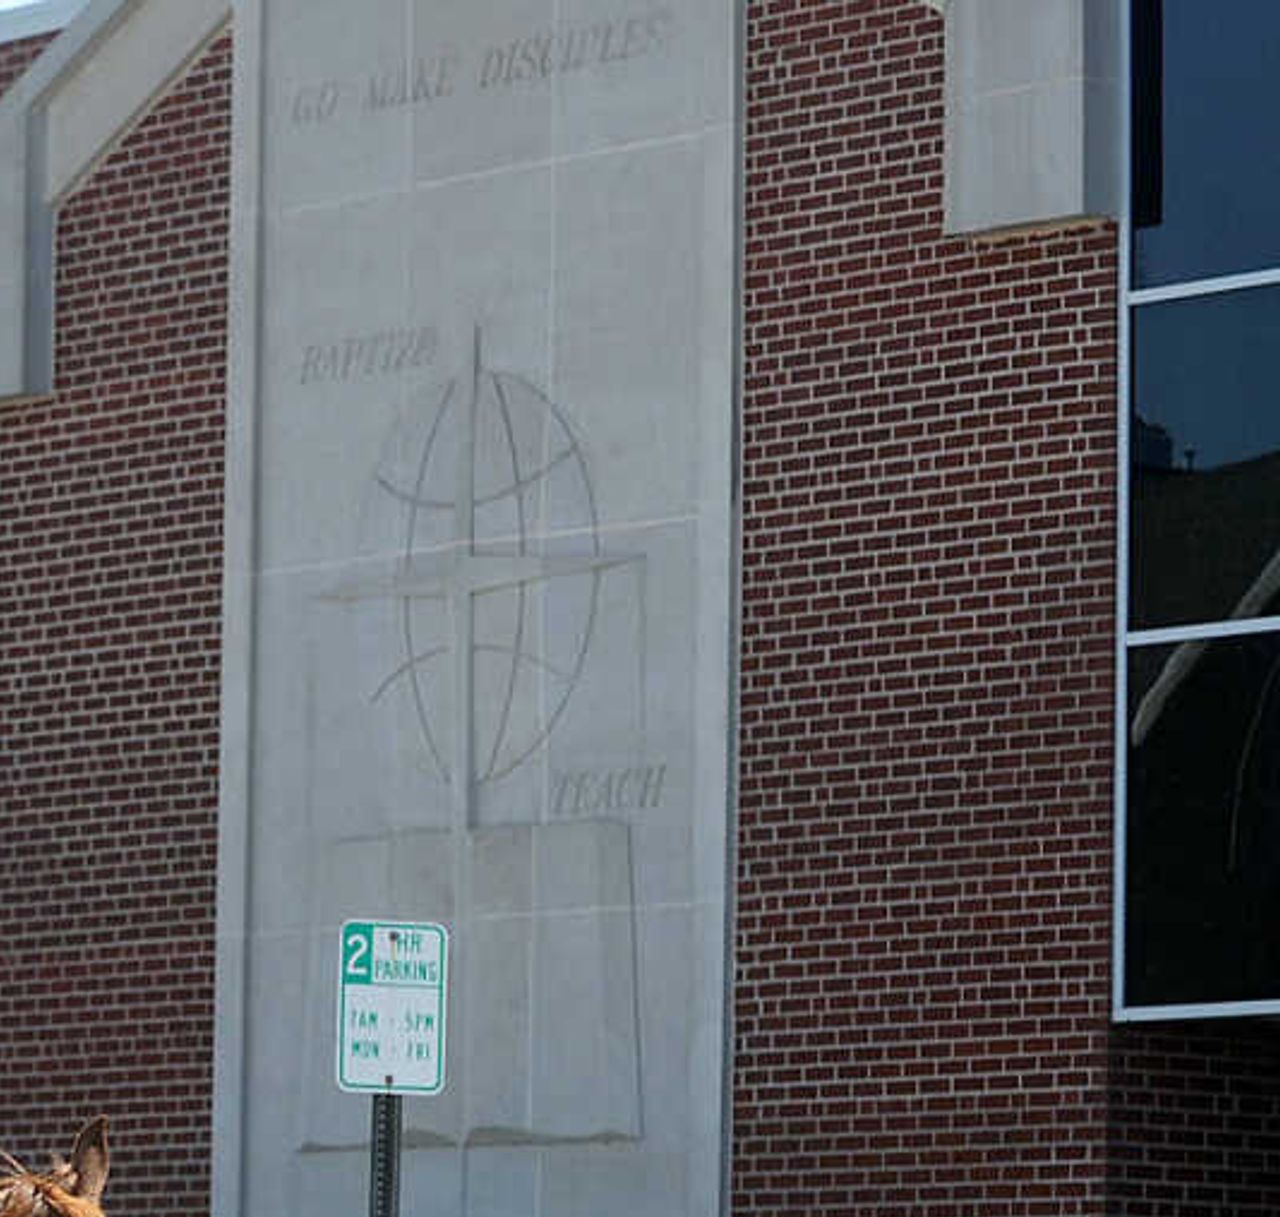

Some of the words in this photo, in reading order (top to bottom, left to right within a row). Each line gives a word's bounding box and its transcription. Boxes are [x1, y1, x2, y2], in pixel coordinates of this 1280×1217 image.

[292, 80, 340, 125] GO
[366, 46, 458, 110] MAKE
[478, 9, 678, 89] DISCIPLES
[550, 764, 667, 814] TEACH
[346, 934, 369, 975] 2
[396, 932, 422, 954] HR
[375, 959, 438, 982] PARKING
[352, 1039, 380, 1058] MON
